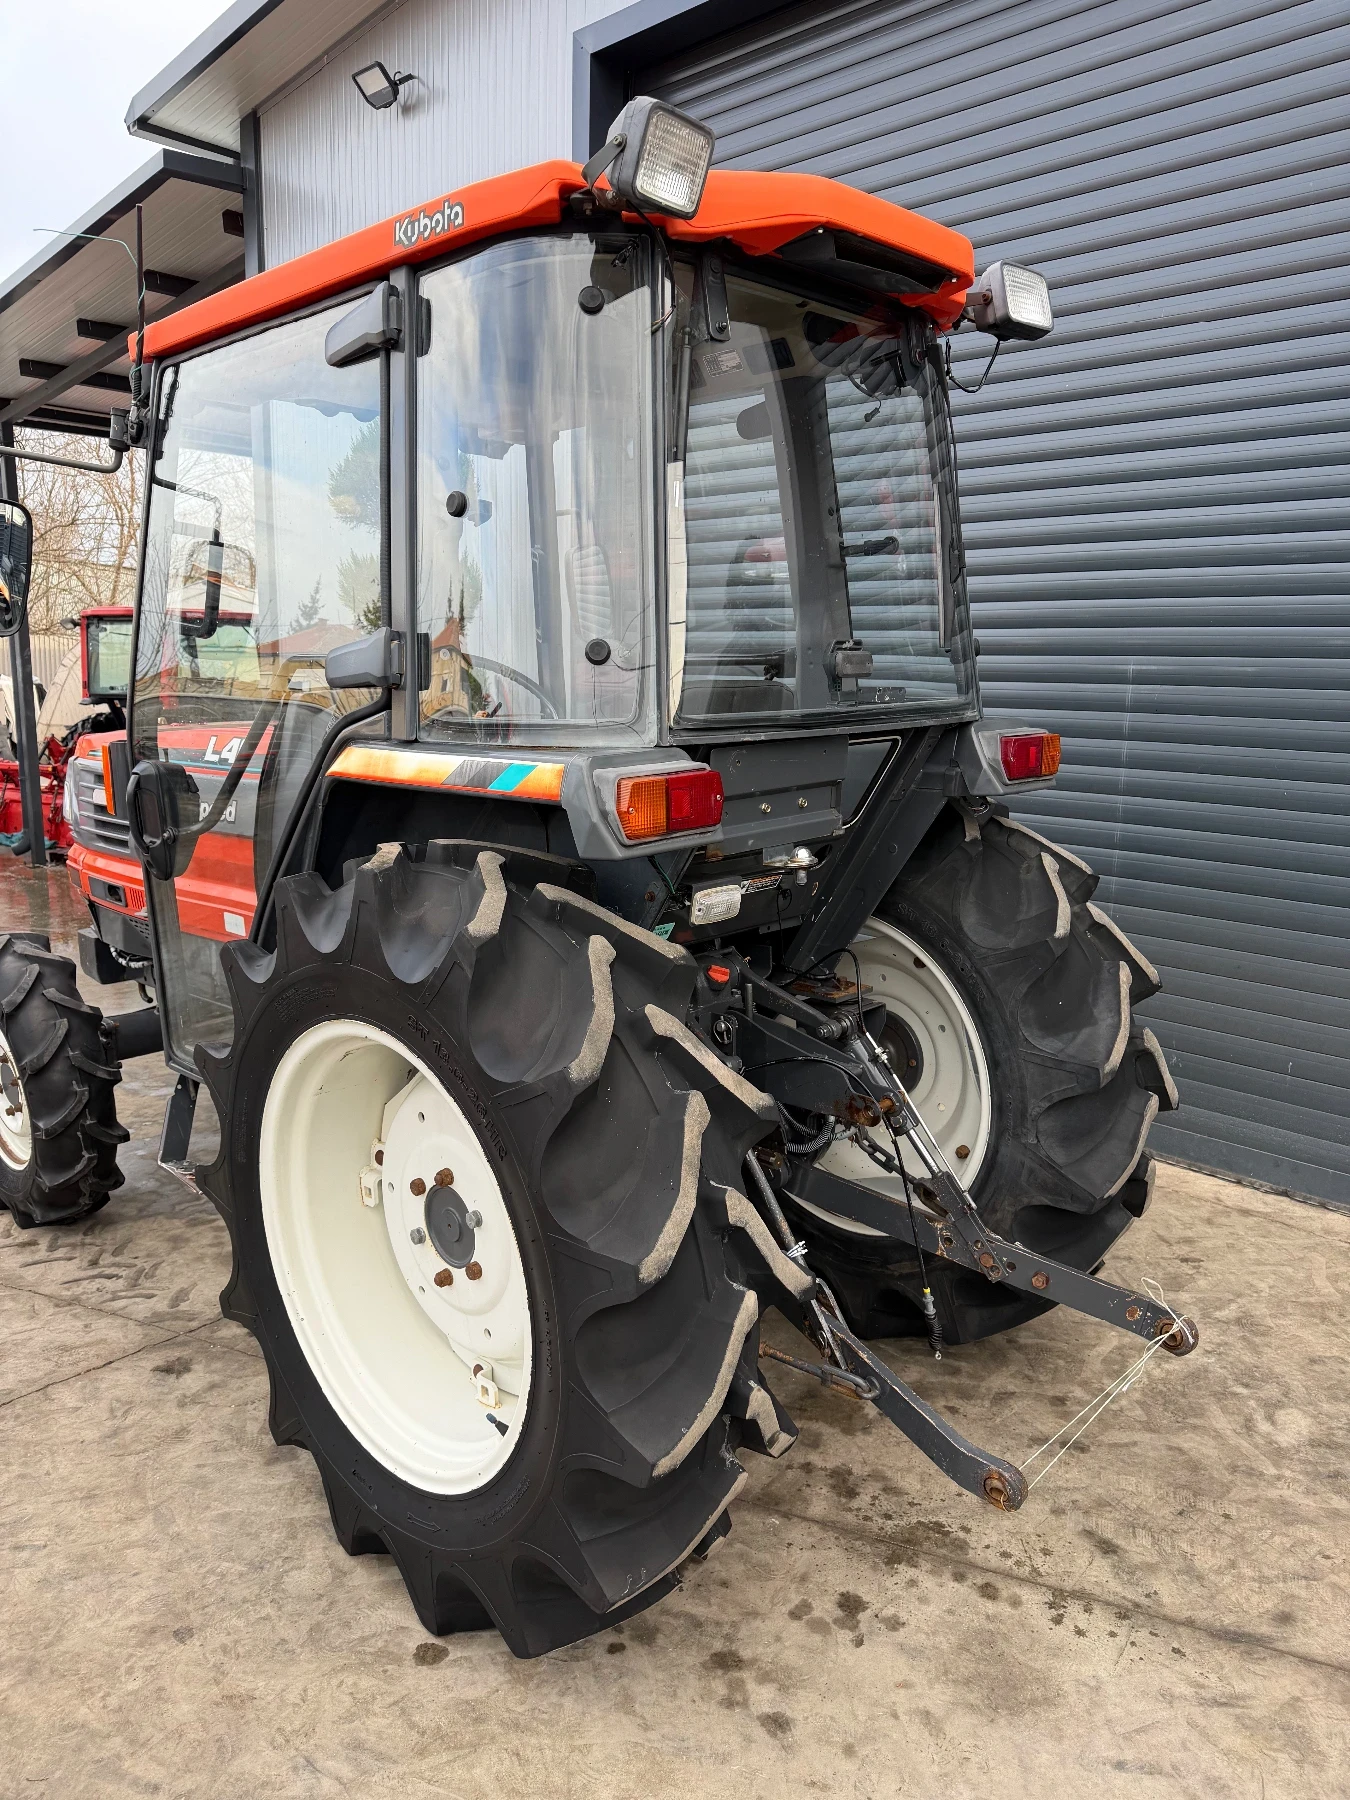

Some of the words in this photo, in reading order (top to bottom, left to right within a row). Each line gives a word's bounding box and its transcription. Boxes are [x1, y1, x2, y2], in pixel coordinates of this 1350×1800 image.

[394, 199, 464, 247] Kubota
[204, 736, 246, 764] L4
[897, 902, 919, 921] ST
[407, 1014, 430, 1042] ST
